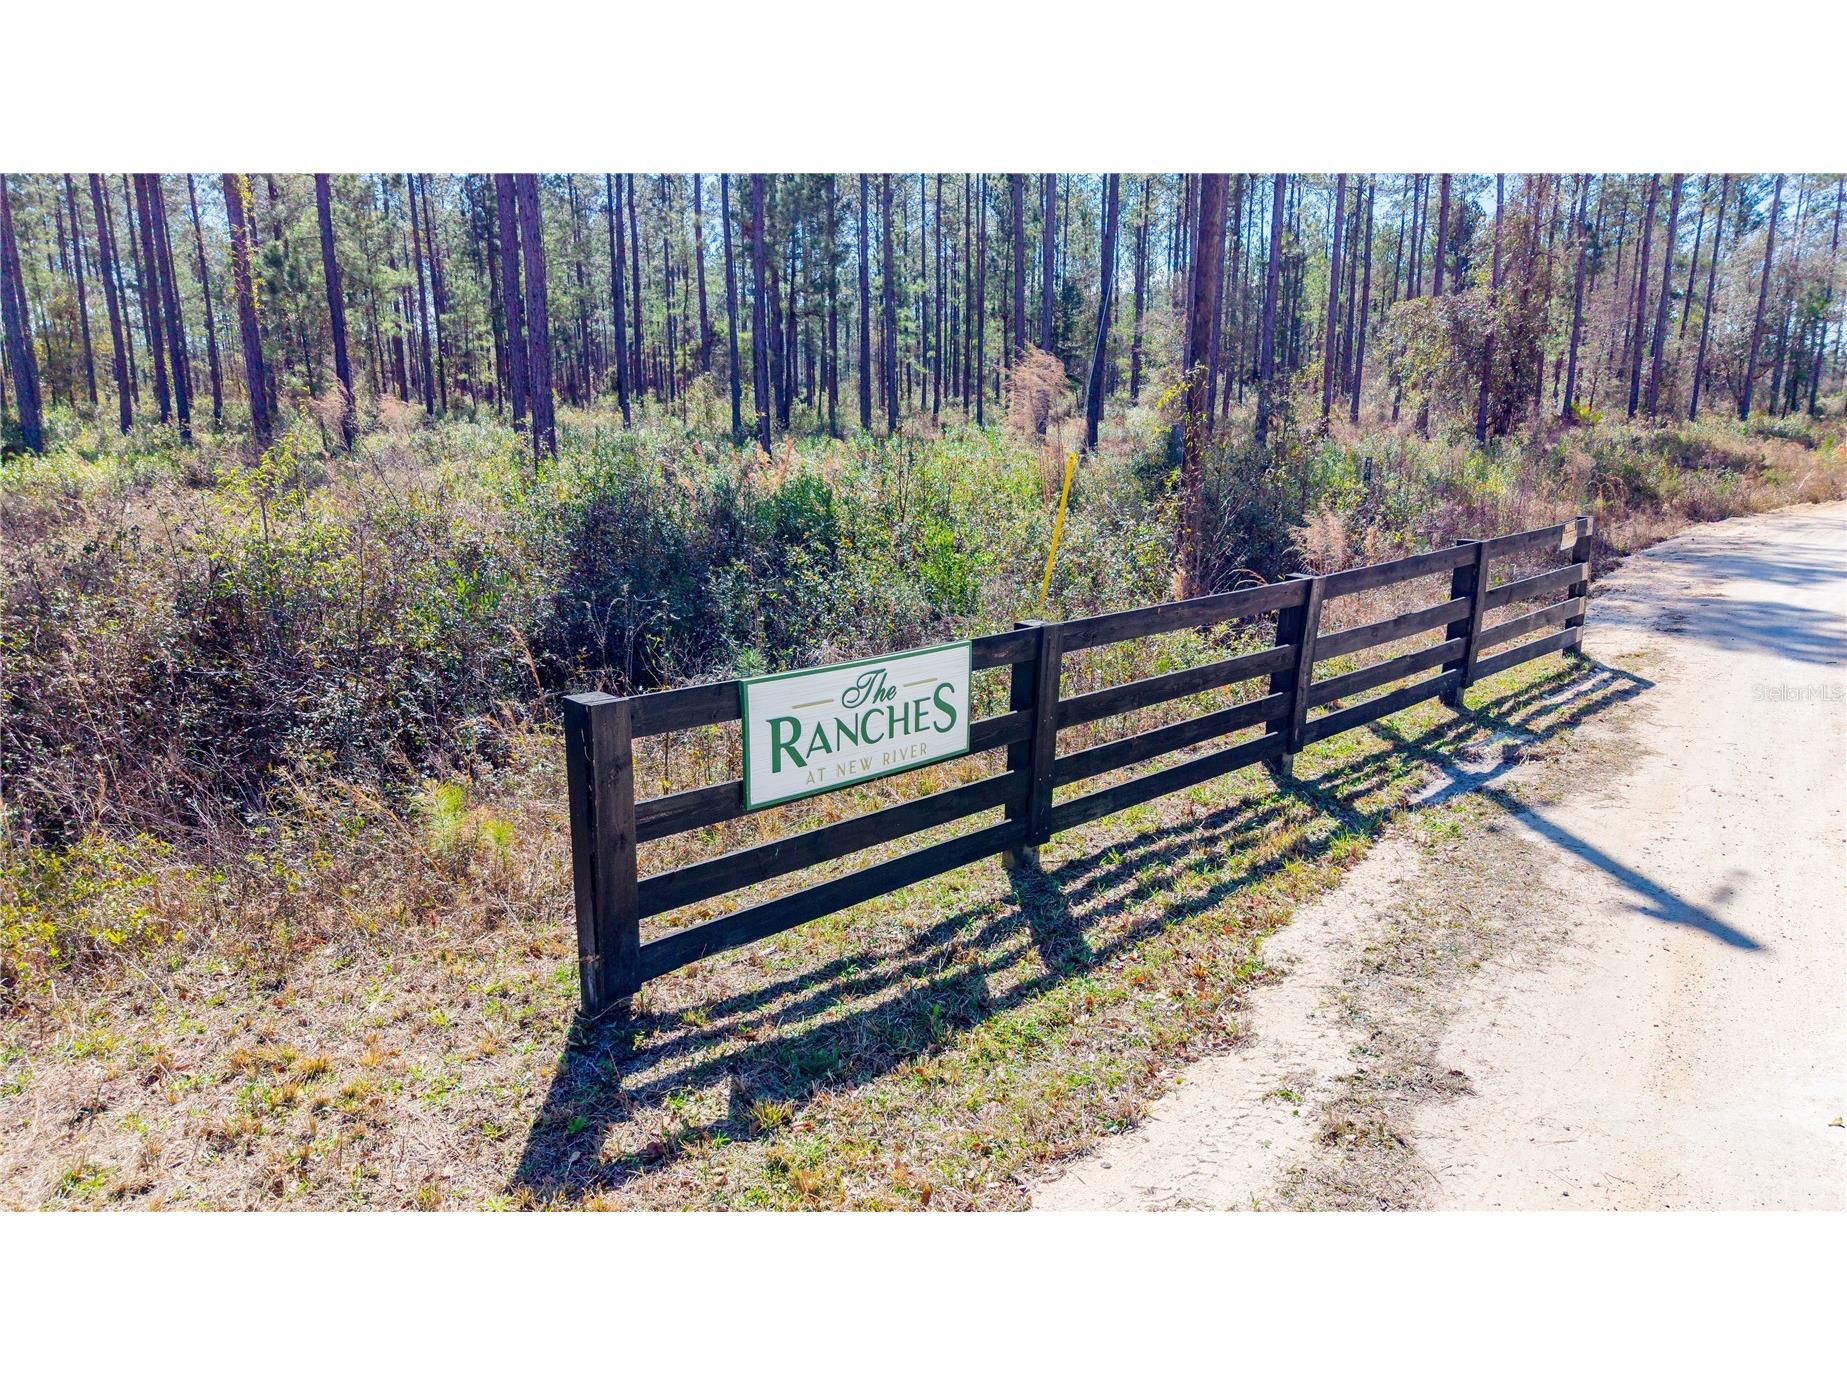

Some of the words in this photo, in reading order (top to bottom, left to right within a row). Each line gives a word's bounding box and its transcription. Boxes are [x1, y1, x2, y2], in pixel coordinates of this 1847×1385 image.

[841, 668, 898, 708] The
[765, 682, 958, 774] RANCHES
[806, 767, 827, 785] AT
[836, 756, 873, 777] NEW
[883, 742, 928, 766] RIVER
